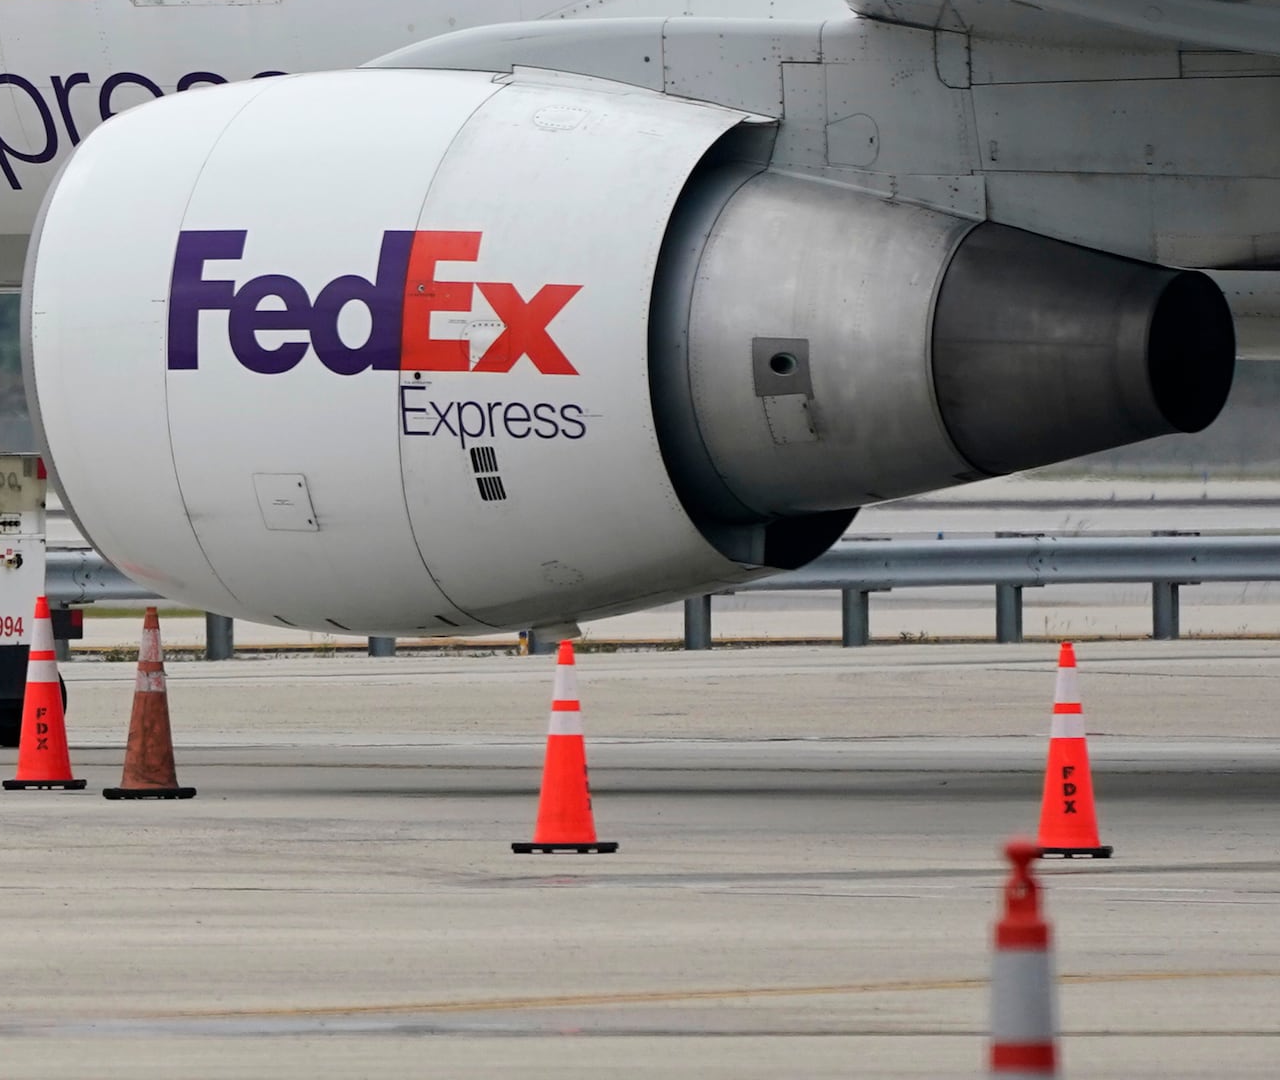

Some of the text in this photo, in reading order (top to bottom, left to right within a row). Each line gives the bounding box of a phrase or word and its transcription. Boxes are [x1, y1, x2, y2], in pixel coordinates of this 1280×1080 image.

[167, 230, 584, 376] FedEx
[399, 385, 587, 449] Express
[36, 707, 48, 750] FDX
[1063, 765, 1077, 814] FDX
